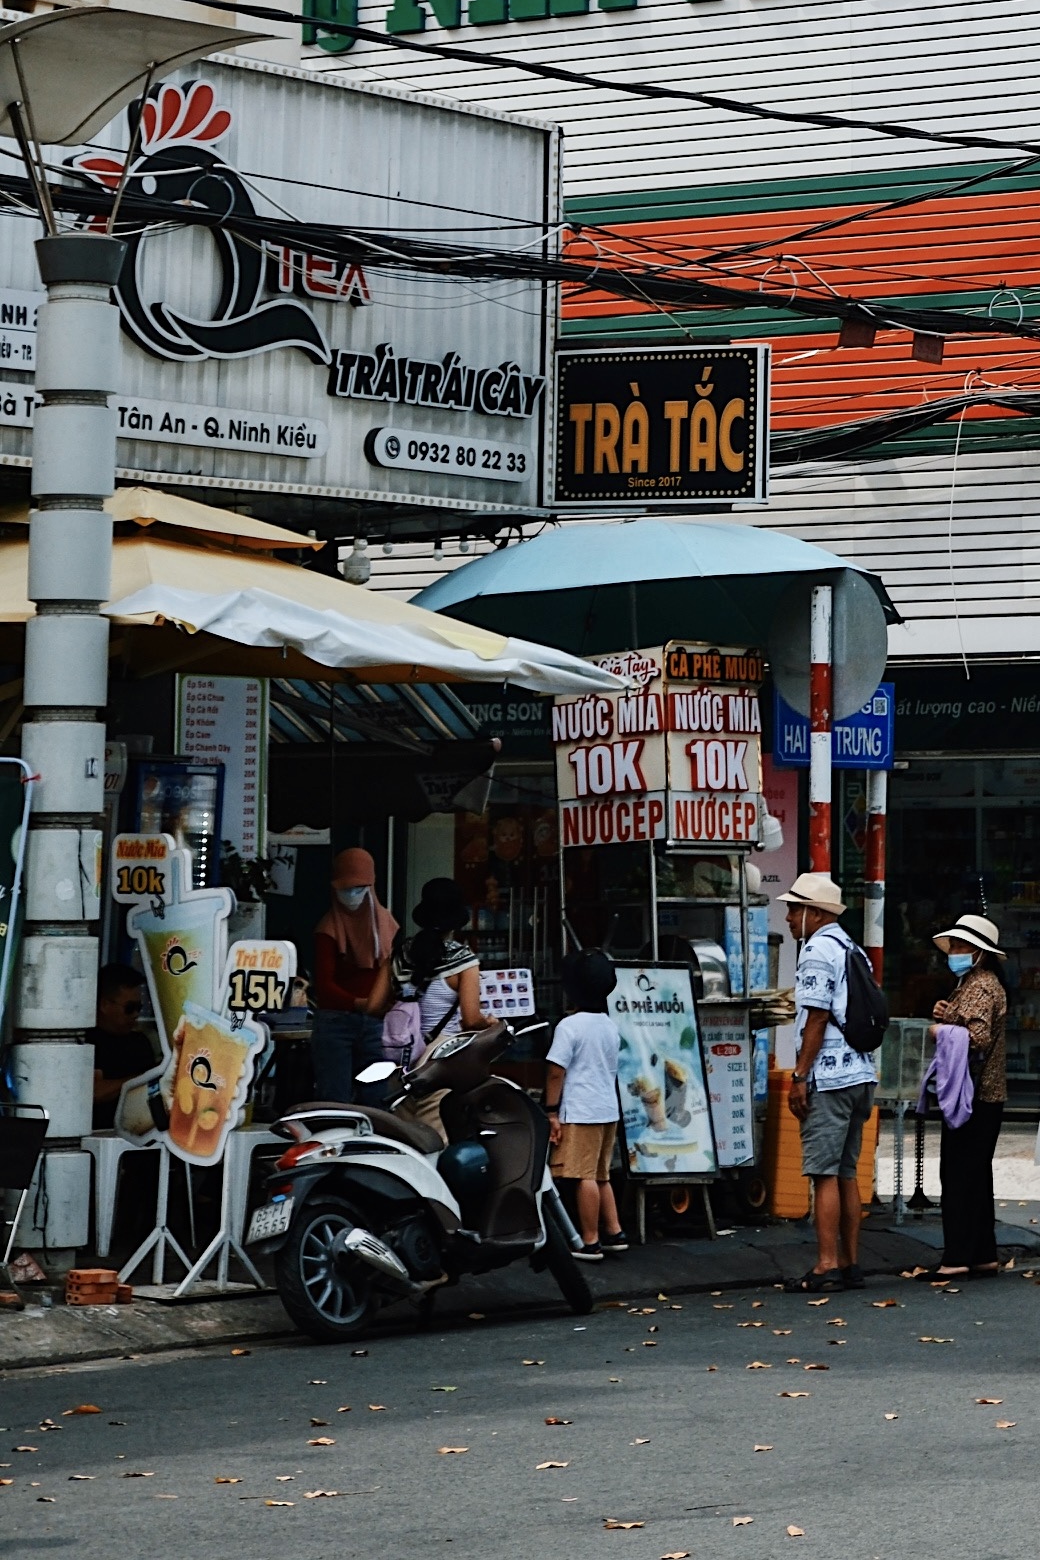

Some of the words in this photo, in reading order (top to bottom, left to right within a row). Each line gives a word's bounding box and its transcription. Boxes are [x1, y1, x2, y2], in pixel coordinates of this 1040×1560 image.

[336, 343, 399, 402] TRÀ
[405, 351, 475, 411] TRÁI
[479, 361, 546, 418] CÂY
[118, 406, 153, 430] Tân
[159, 412, 185, 434] An
[204, 417, 224, 438] Q.
[229, 421, 270, 444] Ninh
[277, 422, 316, 449] Kiều
[569, 382, 649, 475] TRÀ
[664, 366, 745, 473] TẮC
[407, 440, 450, 464] 0932
[456, 446, 476, 467] 80
[481, 450, 501, 470] 22
[506, 452, 526, 473] 33
[627, 476, 655, 488] Since
[658, 476, 681, 487] 2017
[552, 694, 610, 741] NƯỚC
[618, 688, 660, 734] MÍA
[674, 687, 724, 732] NƯỚC
[728, 689, 762, 733] MÍA
[915, 699, 963, 718] lượng
[967, 700, 996, 714] cao
[784, 724, 807, 754] HAI
[834, 726, 882, 757] TRƯNG
[569, 741, 646, 796] 10K
[690, 740, 749, 791] 10K
[118, 867, 164, 894] 10k
[231, 972, 285, 1011] 15k
[731, 1077, 744, 1087] 10K
[731, 1094, 744, 1103] 20K
[732, 1109, 745, 1119] 20K
[732, 1124, 745, 1134] 20K
[733, 1140, 746, 1150] 20K
